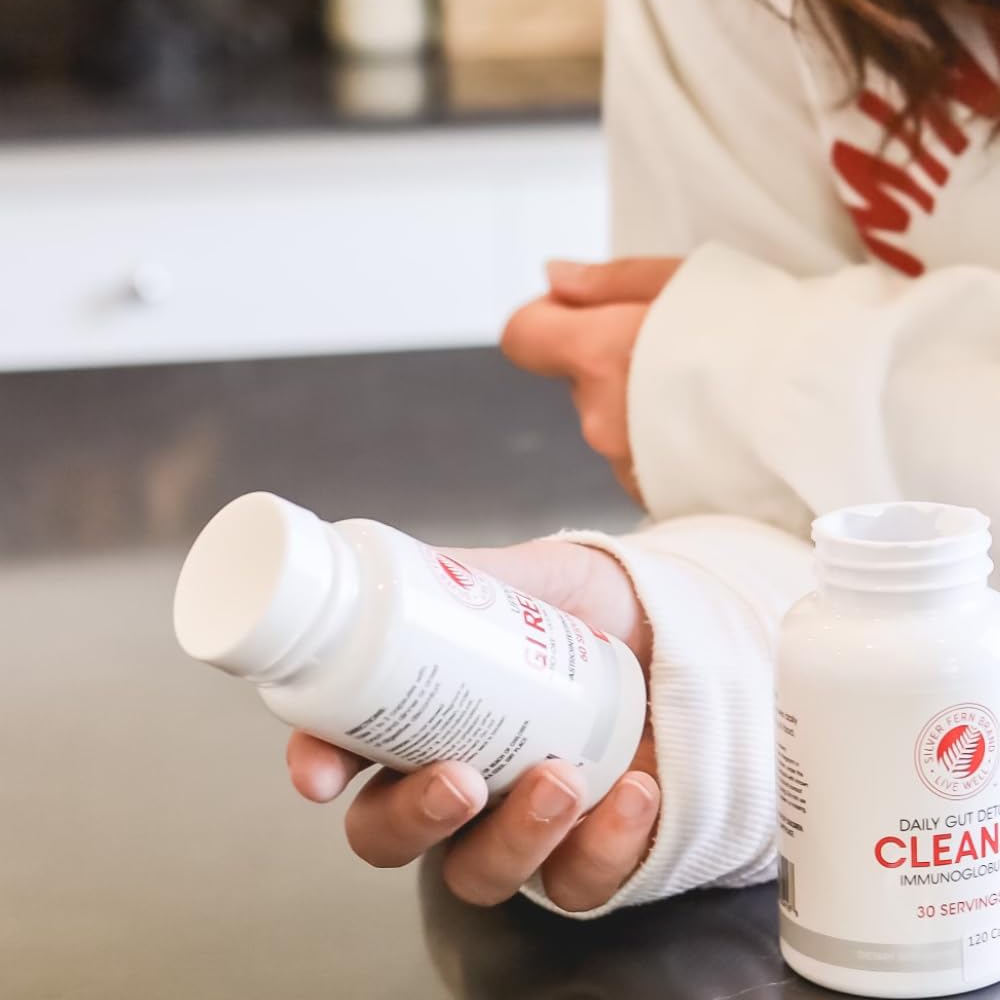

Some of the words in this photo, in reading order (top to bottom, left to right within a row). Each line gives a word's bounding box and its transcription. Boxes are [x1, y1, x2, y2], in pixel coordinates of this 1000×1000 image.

[923, 724, 944, 763] SILVER
[946, 712, 976, 726] FERN
[935, 776, 959, 792] LIVE
[963, 768, 988, 790] WELL
[900, 817, 940, 832] DAILY
[945, 811, 974, 828] GUT
[917, 905, 935, 919] 30
[968, 932, 989, 947] 120
